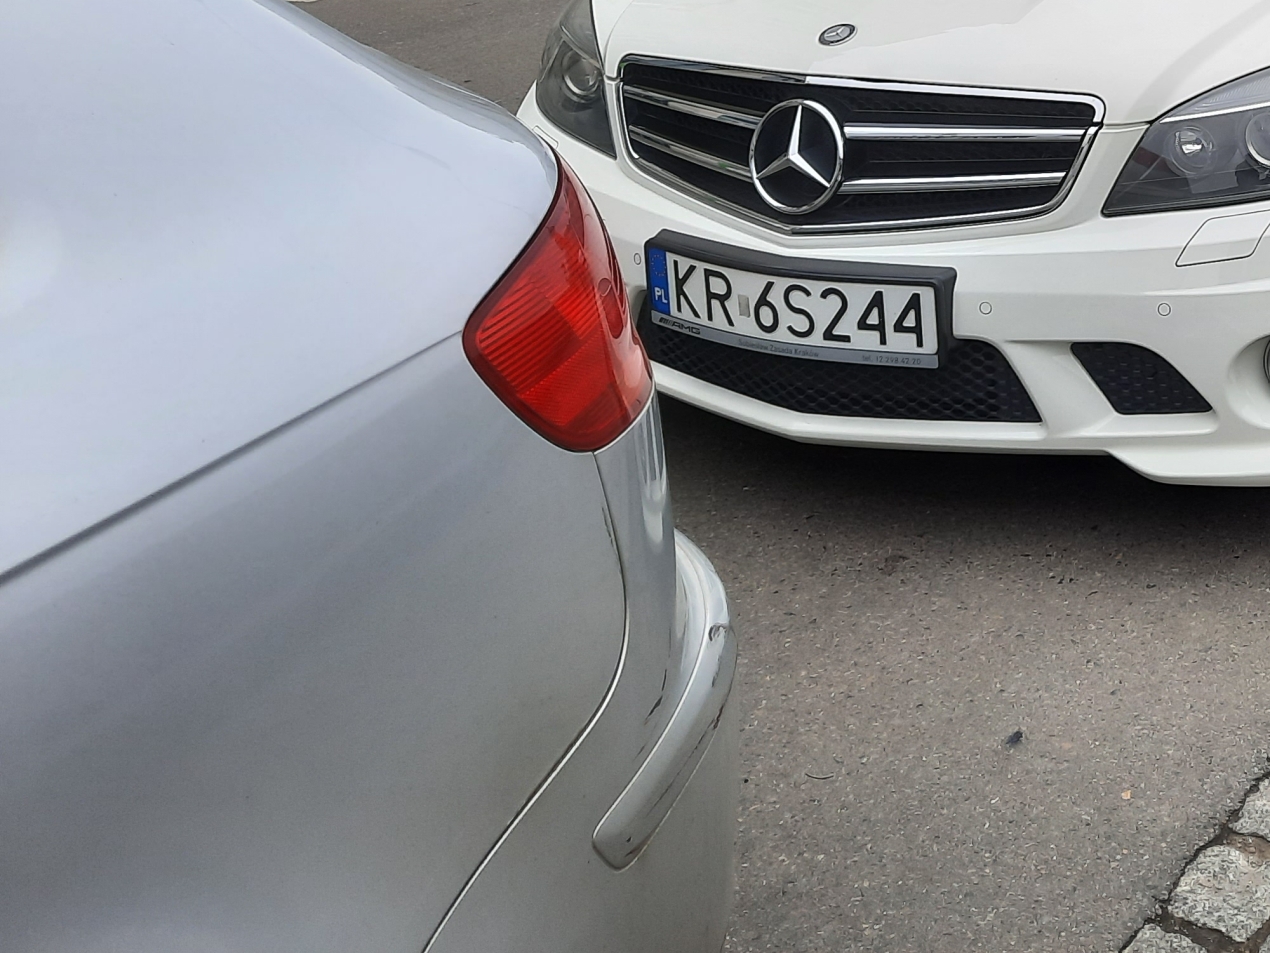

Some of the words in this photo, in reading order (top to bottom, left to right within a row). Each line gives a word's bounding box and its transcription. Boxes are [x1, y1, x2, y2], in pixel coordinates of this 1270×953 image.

[654, 287, 668, 304] PL
[672, 259, 735, 327] KR
[754, 280, 924, 348] 6S244
[671, 320, 701, 335] AMG
[769, 344, 793, 355] Zasada
[794, 348, 819, 358] Kraków
[876, 355, 883, 363] 12
